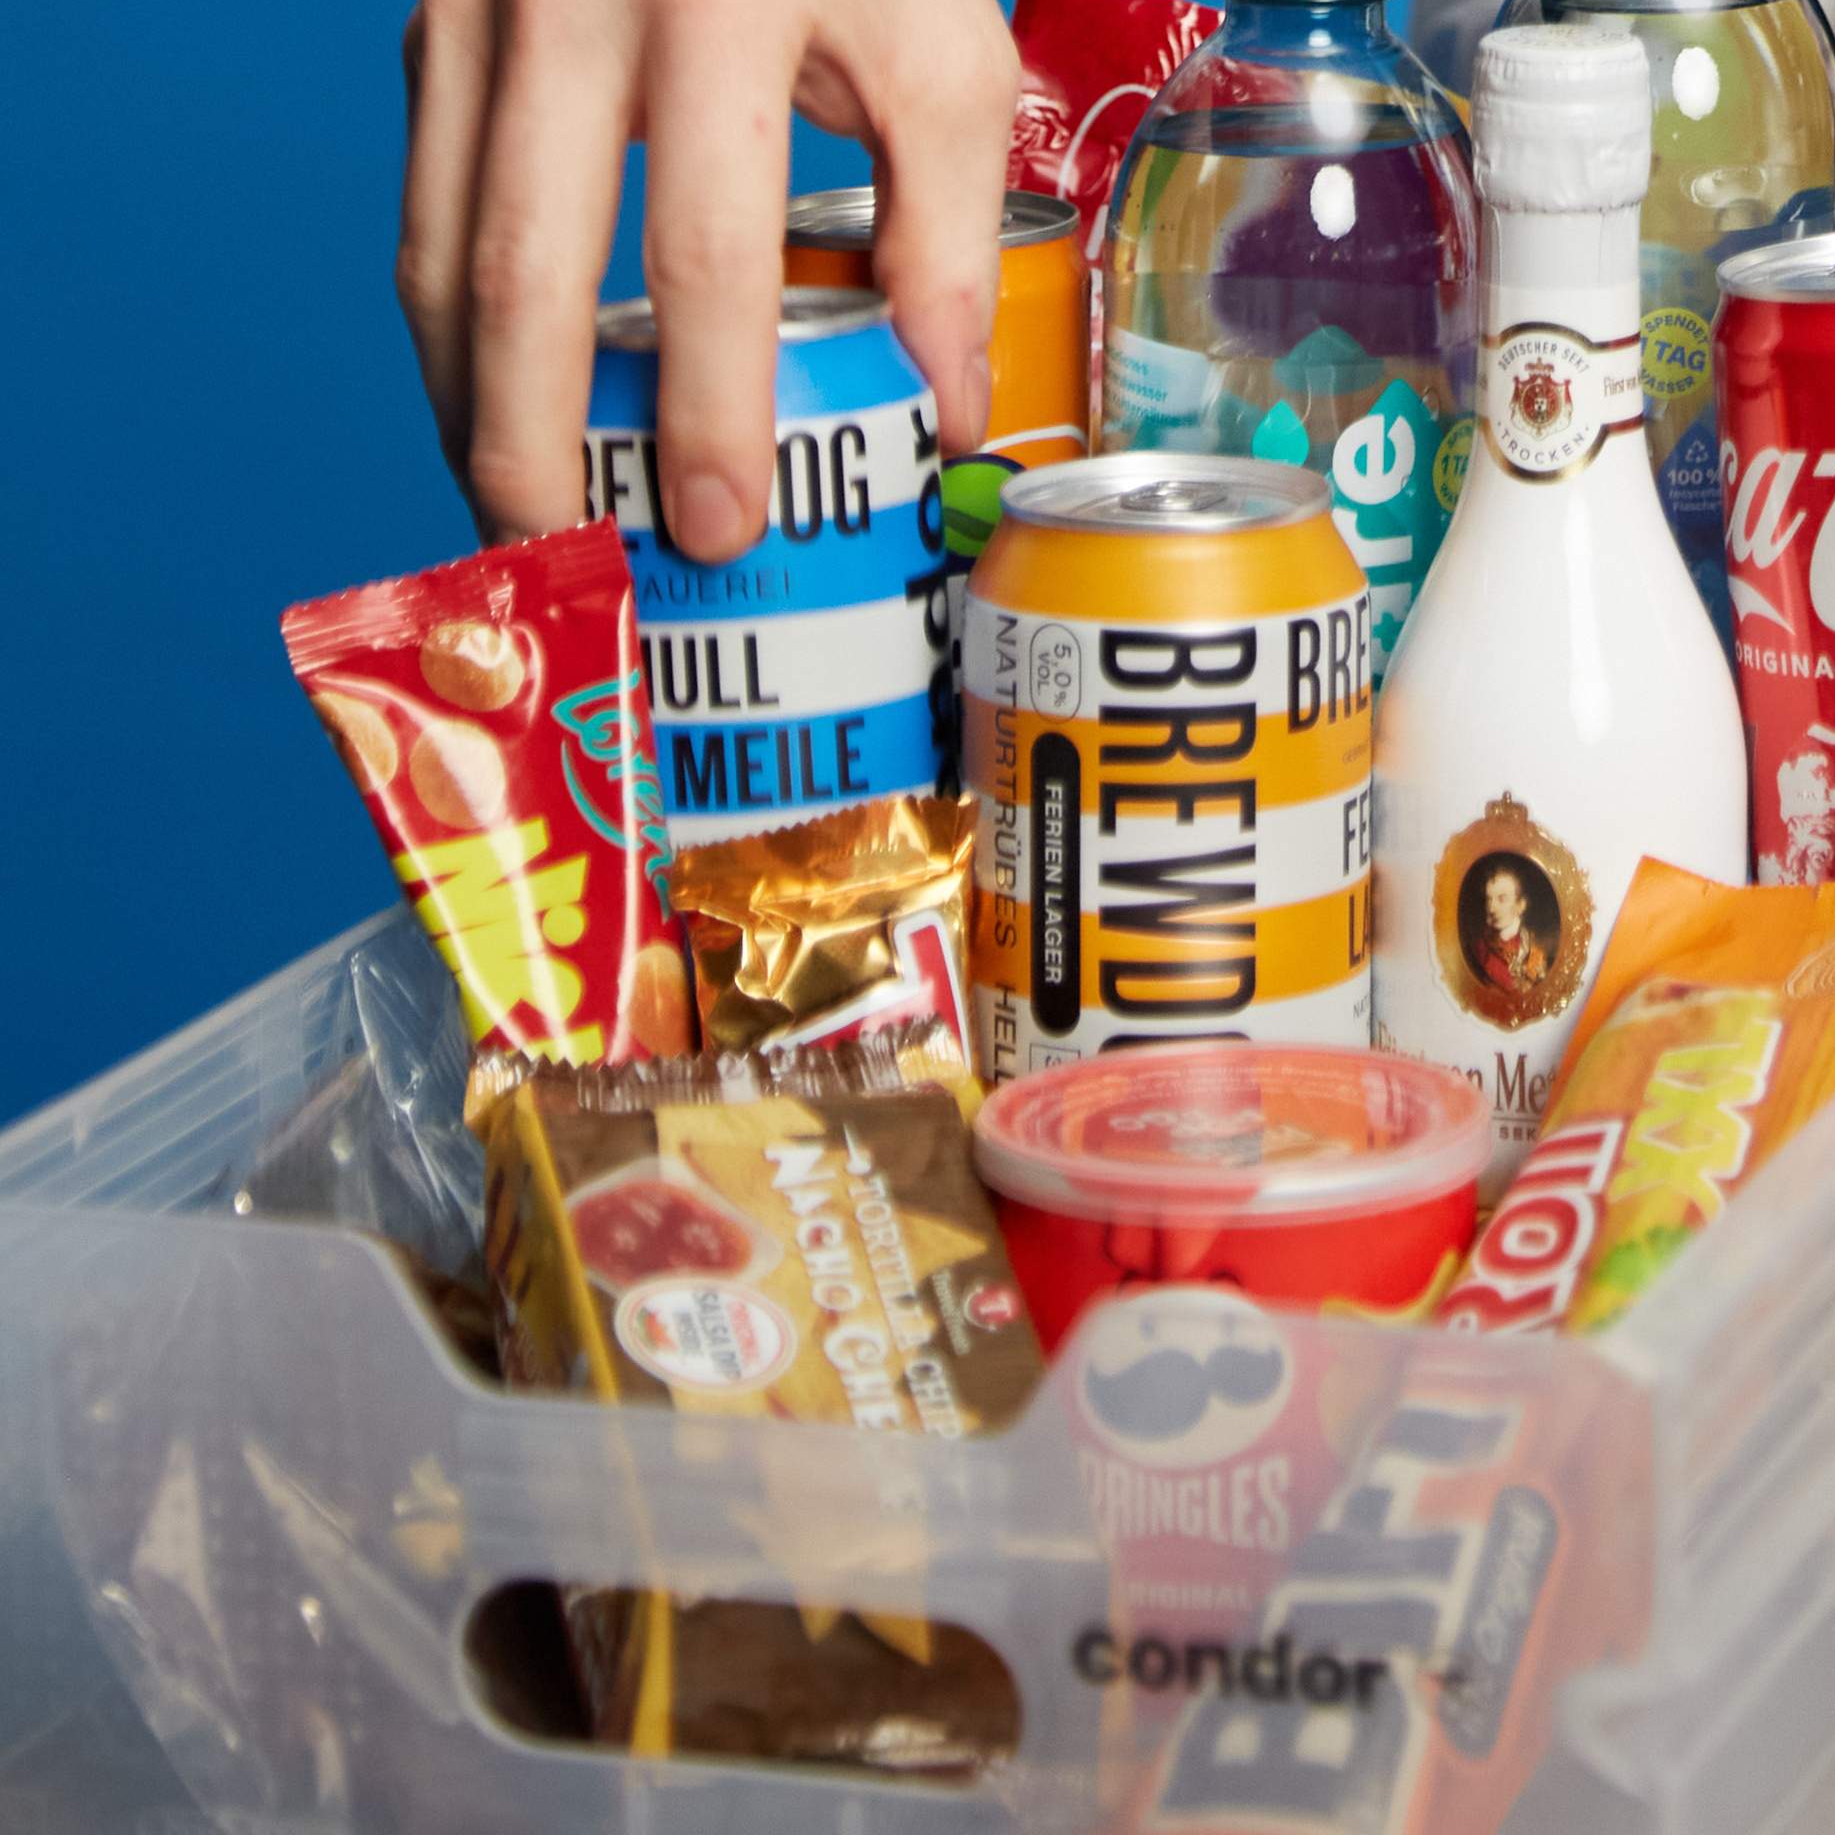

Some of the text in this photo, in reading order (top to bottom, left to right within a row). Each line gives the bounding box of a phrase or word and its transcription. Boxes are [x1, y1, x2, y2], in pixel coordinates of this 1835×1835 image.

[1498, 340, 1592, 374] DEUTSCHER SEKT
[1655, 339, 1706, 372] TAG
[1500, 427, 1586, 465] TROCKEN
[1667, 468, 1703, 485] 100
[642, 568, 791, 604] AUEREI
[1287, 593, 1372, 735] BRE
[671, 717, 870, 809] MEILE
[993, 614, 1022, 1088] NATURTRÜBES HELL
[1044, 782, 1064, 985] FERIEN LAGER
[1099, 627, 1257, 1053] BREWD
[1498, 1126, 1537, 1141] SEK
[764, 1142, 866, 1314] NACHO
[847, 1173, 932, 1353] TORTILLA
[904, 1356, 965, 1441] CHIP
[1070, 1622, 1387, 1713] condor
